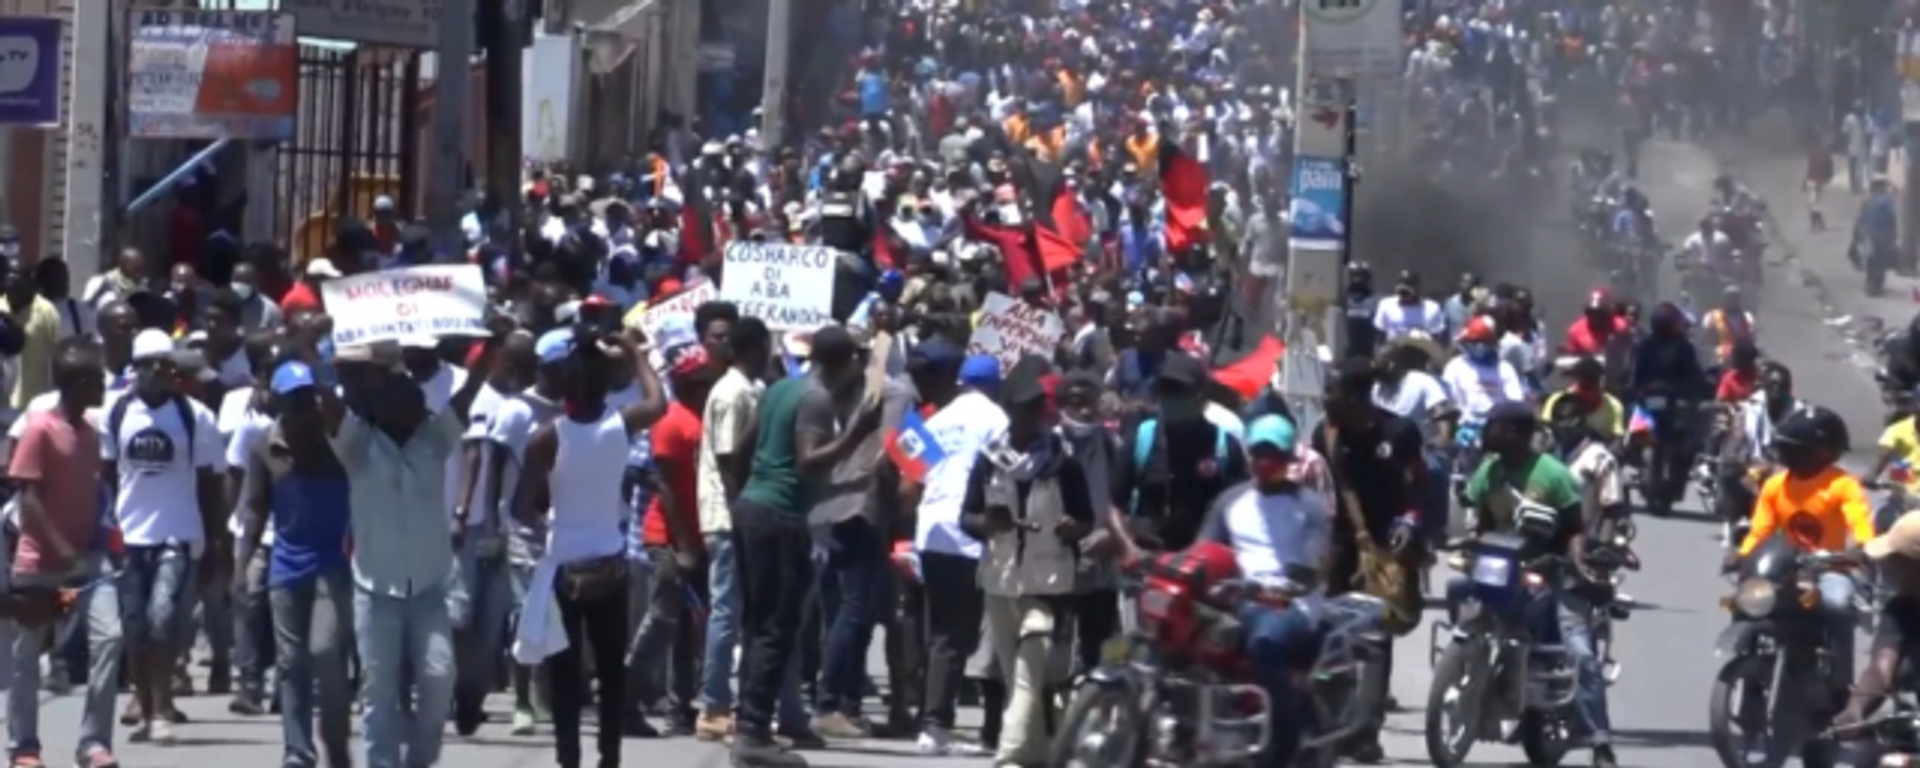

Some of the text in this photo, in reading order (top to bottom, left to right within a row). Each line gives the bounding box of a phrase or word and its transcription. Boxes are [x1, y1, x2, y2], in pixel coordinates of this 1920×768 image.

[764, 267, 781, 281] DI
[750, 280, 791, 299] ABA
[336, 328, 366, 344] ABA
